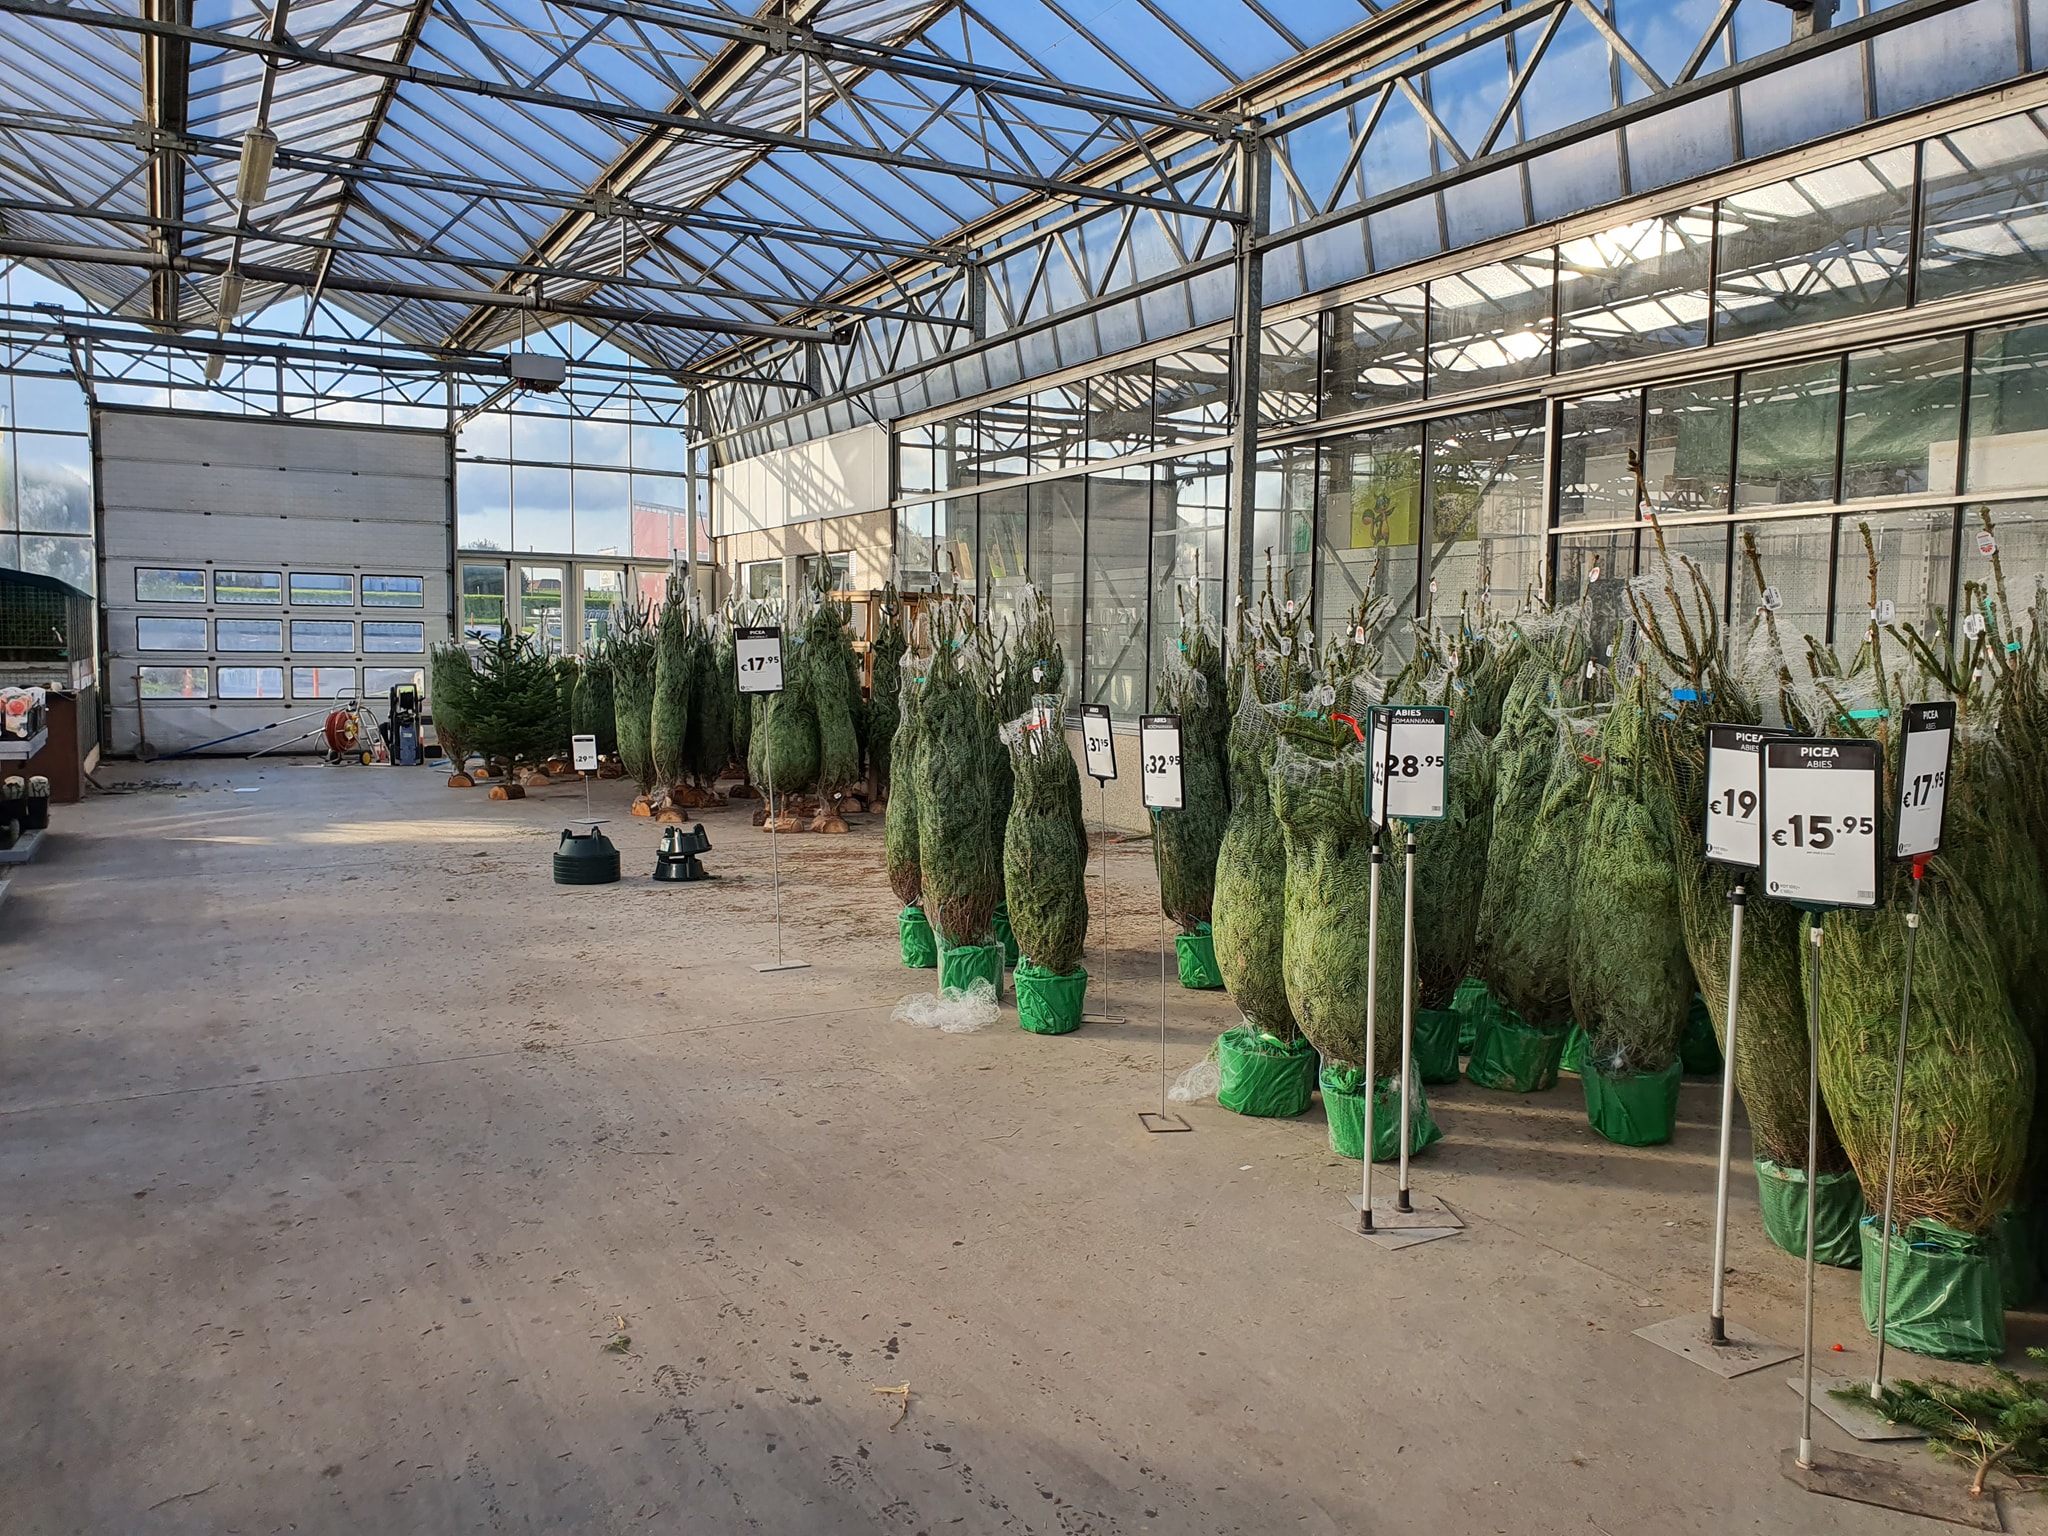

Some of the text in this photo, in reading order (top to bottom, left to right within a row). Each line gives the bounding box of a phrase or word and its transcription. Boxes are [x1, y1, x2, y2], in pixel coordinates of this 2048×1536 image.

[741, 656, 780, 671] €17.95
[1395, 709, 1422, 717] ABIES
[1923, 709, 1939, 720] PICEA
[1800, 747, 1840, 758] PICEA
[1145, 755, 1182, 774] €32.95
[1806, 760, 1833, 768] ABIES
[1903, 772, 1945, 808] €17.95
[1771, 814, 1874, 850] €15.95
